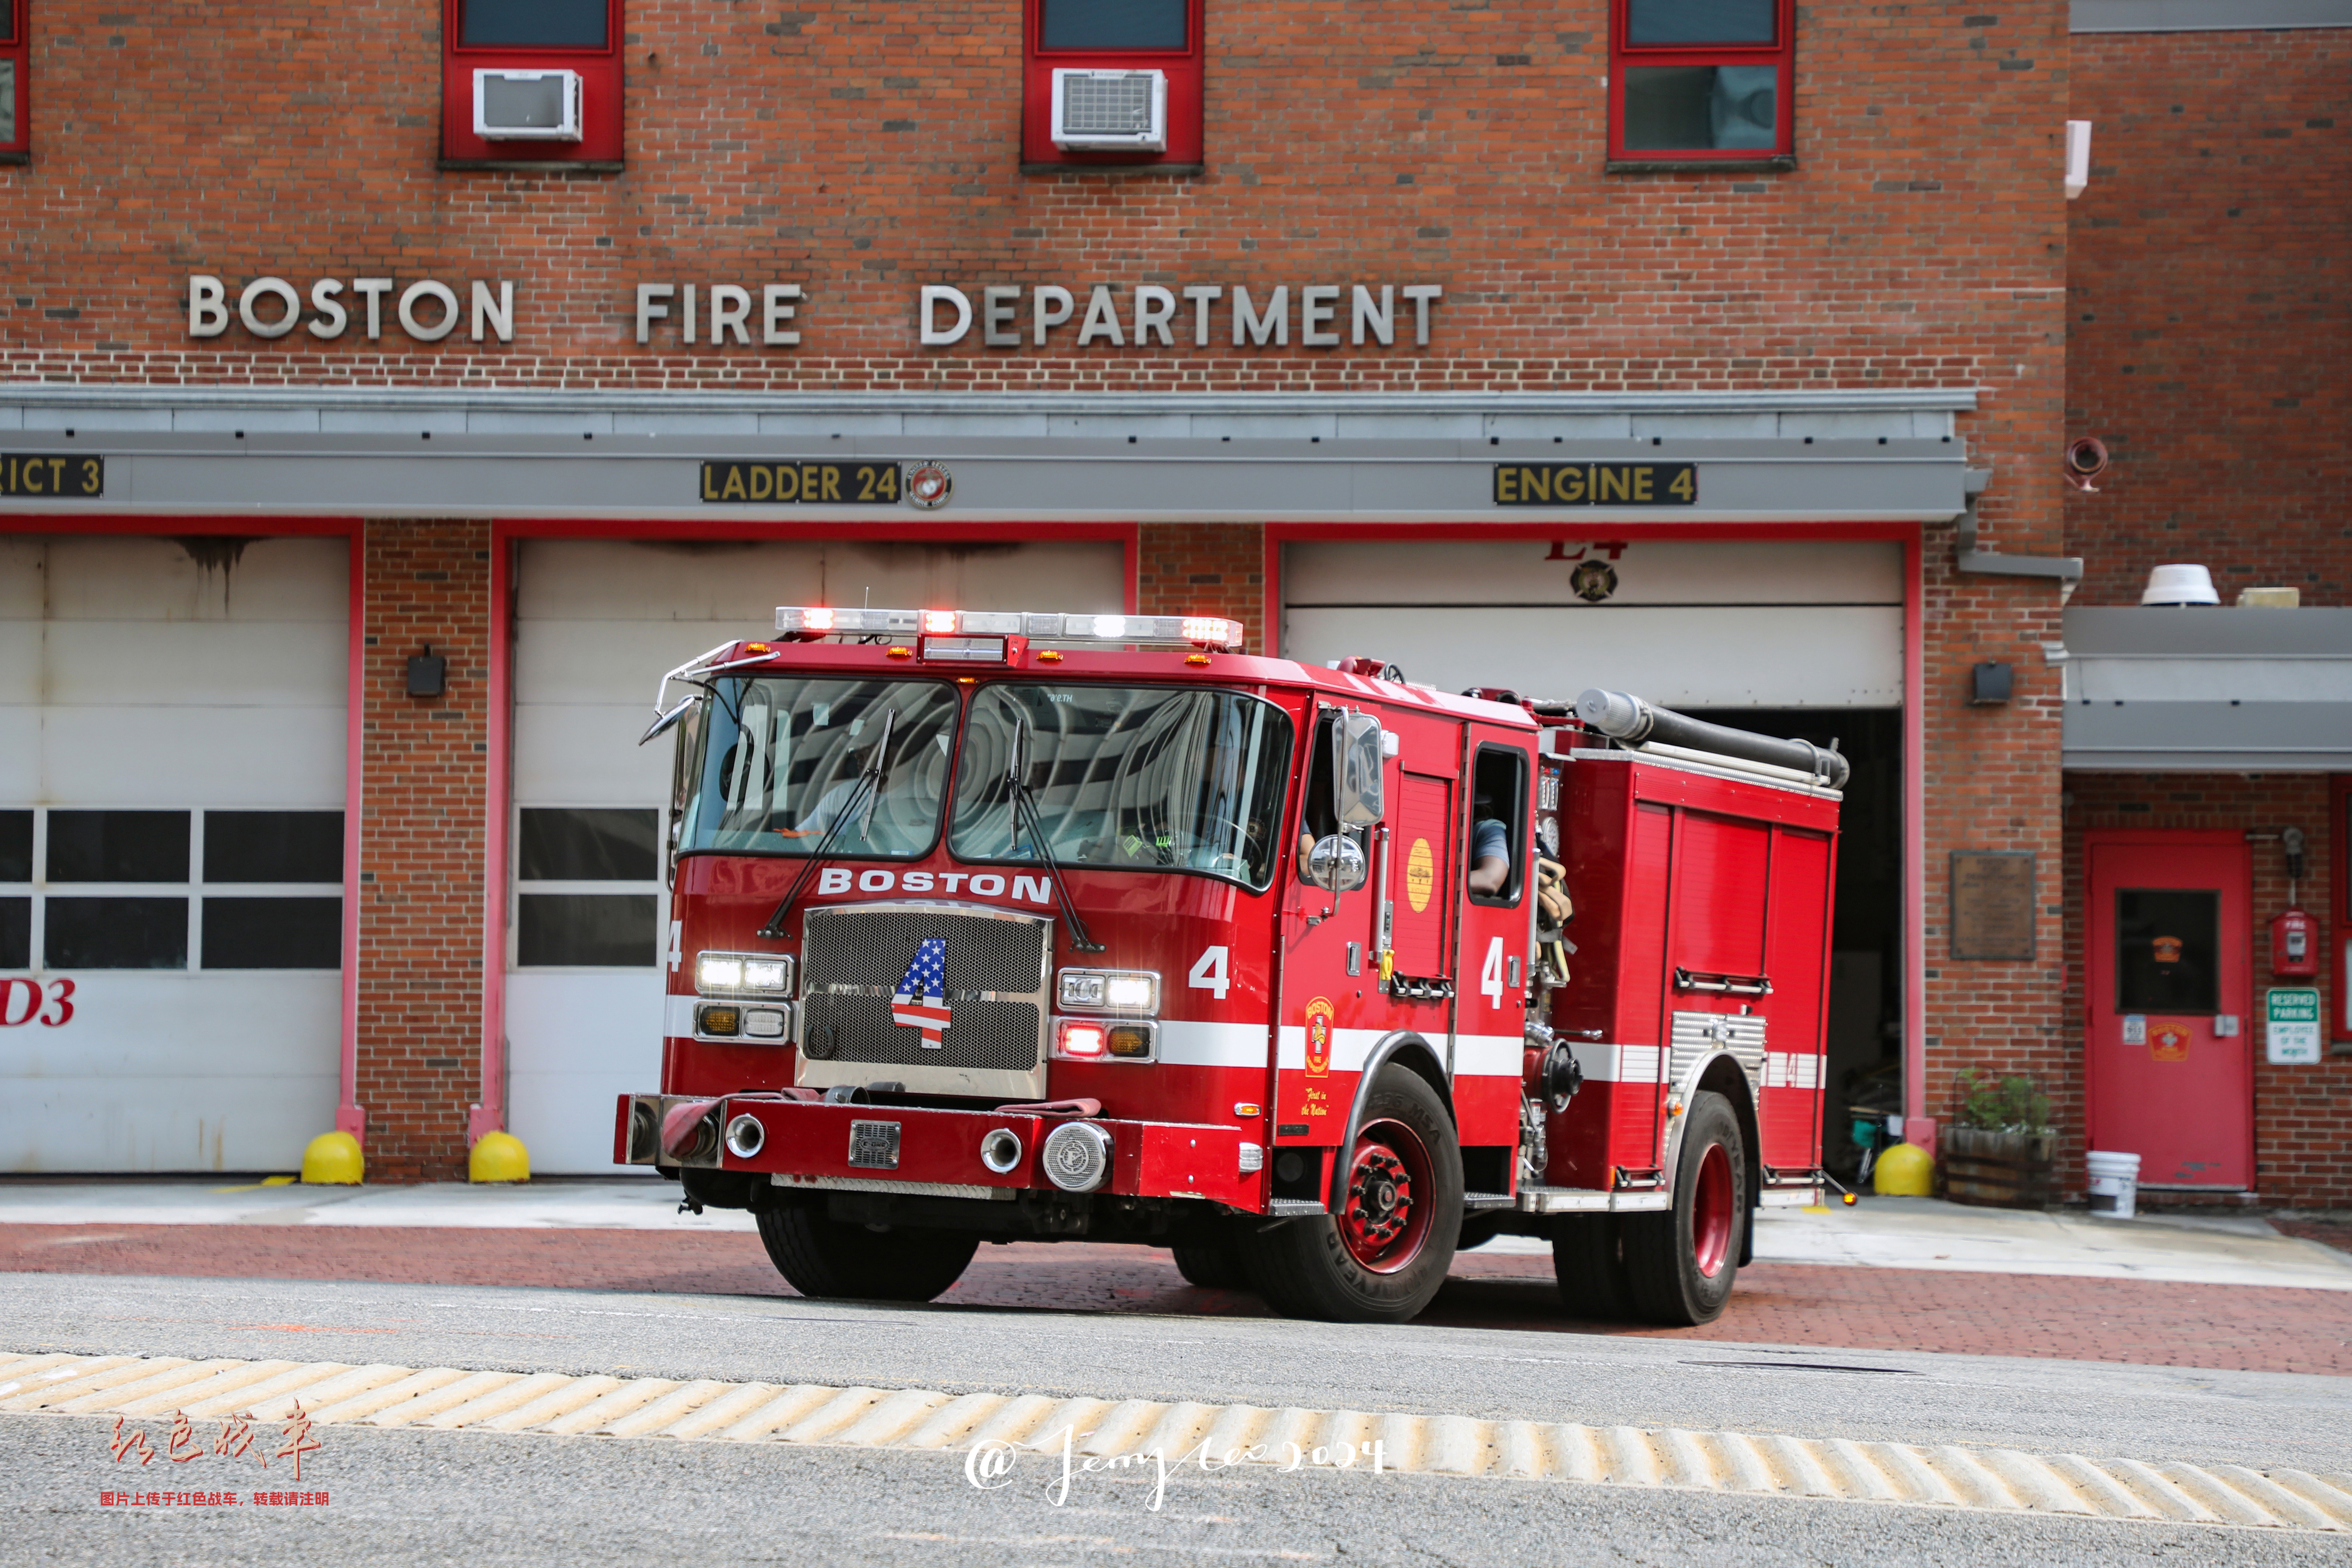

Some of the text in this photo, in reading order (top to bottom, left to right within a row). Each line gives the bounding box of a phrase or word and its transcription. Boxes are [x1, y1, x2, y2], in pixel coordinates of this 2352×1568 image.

[189, 274, 1443, 346] BOSTON FIRE DEPARTMENT
[0, 457, 100, 494] ICT 3
[704, 465, 897, 501] LADDER 24
[1497, 467, 1694, 501] ENGINE 4
[818, 867, 1052, 905] BOSTON
[1188, 945, 1230, 1000] 4
[1480, 936, 1504, 1010] 4
[890, 938, 951, 1050] 4
[1307, 1001, 1333, 1020] BOSTON
[2271, 993, 2316, 1006] RESERVED
[2273, 1007, 2314, 1020] PARKING
[1301, 1104, 1310, 1116] the
[1321, 1092, 1327, 1100] in
